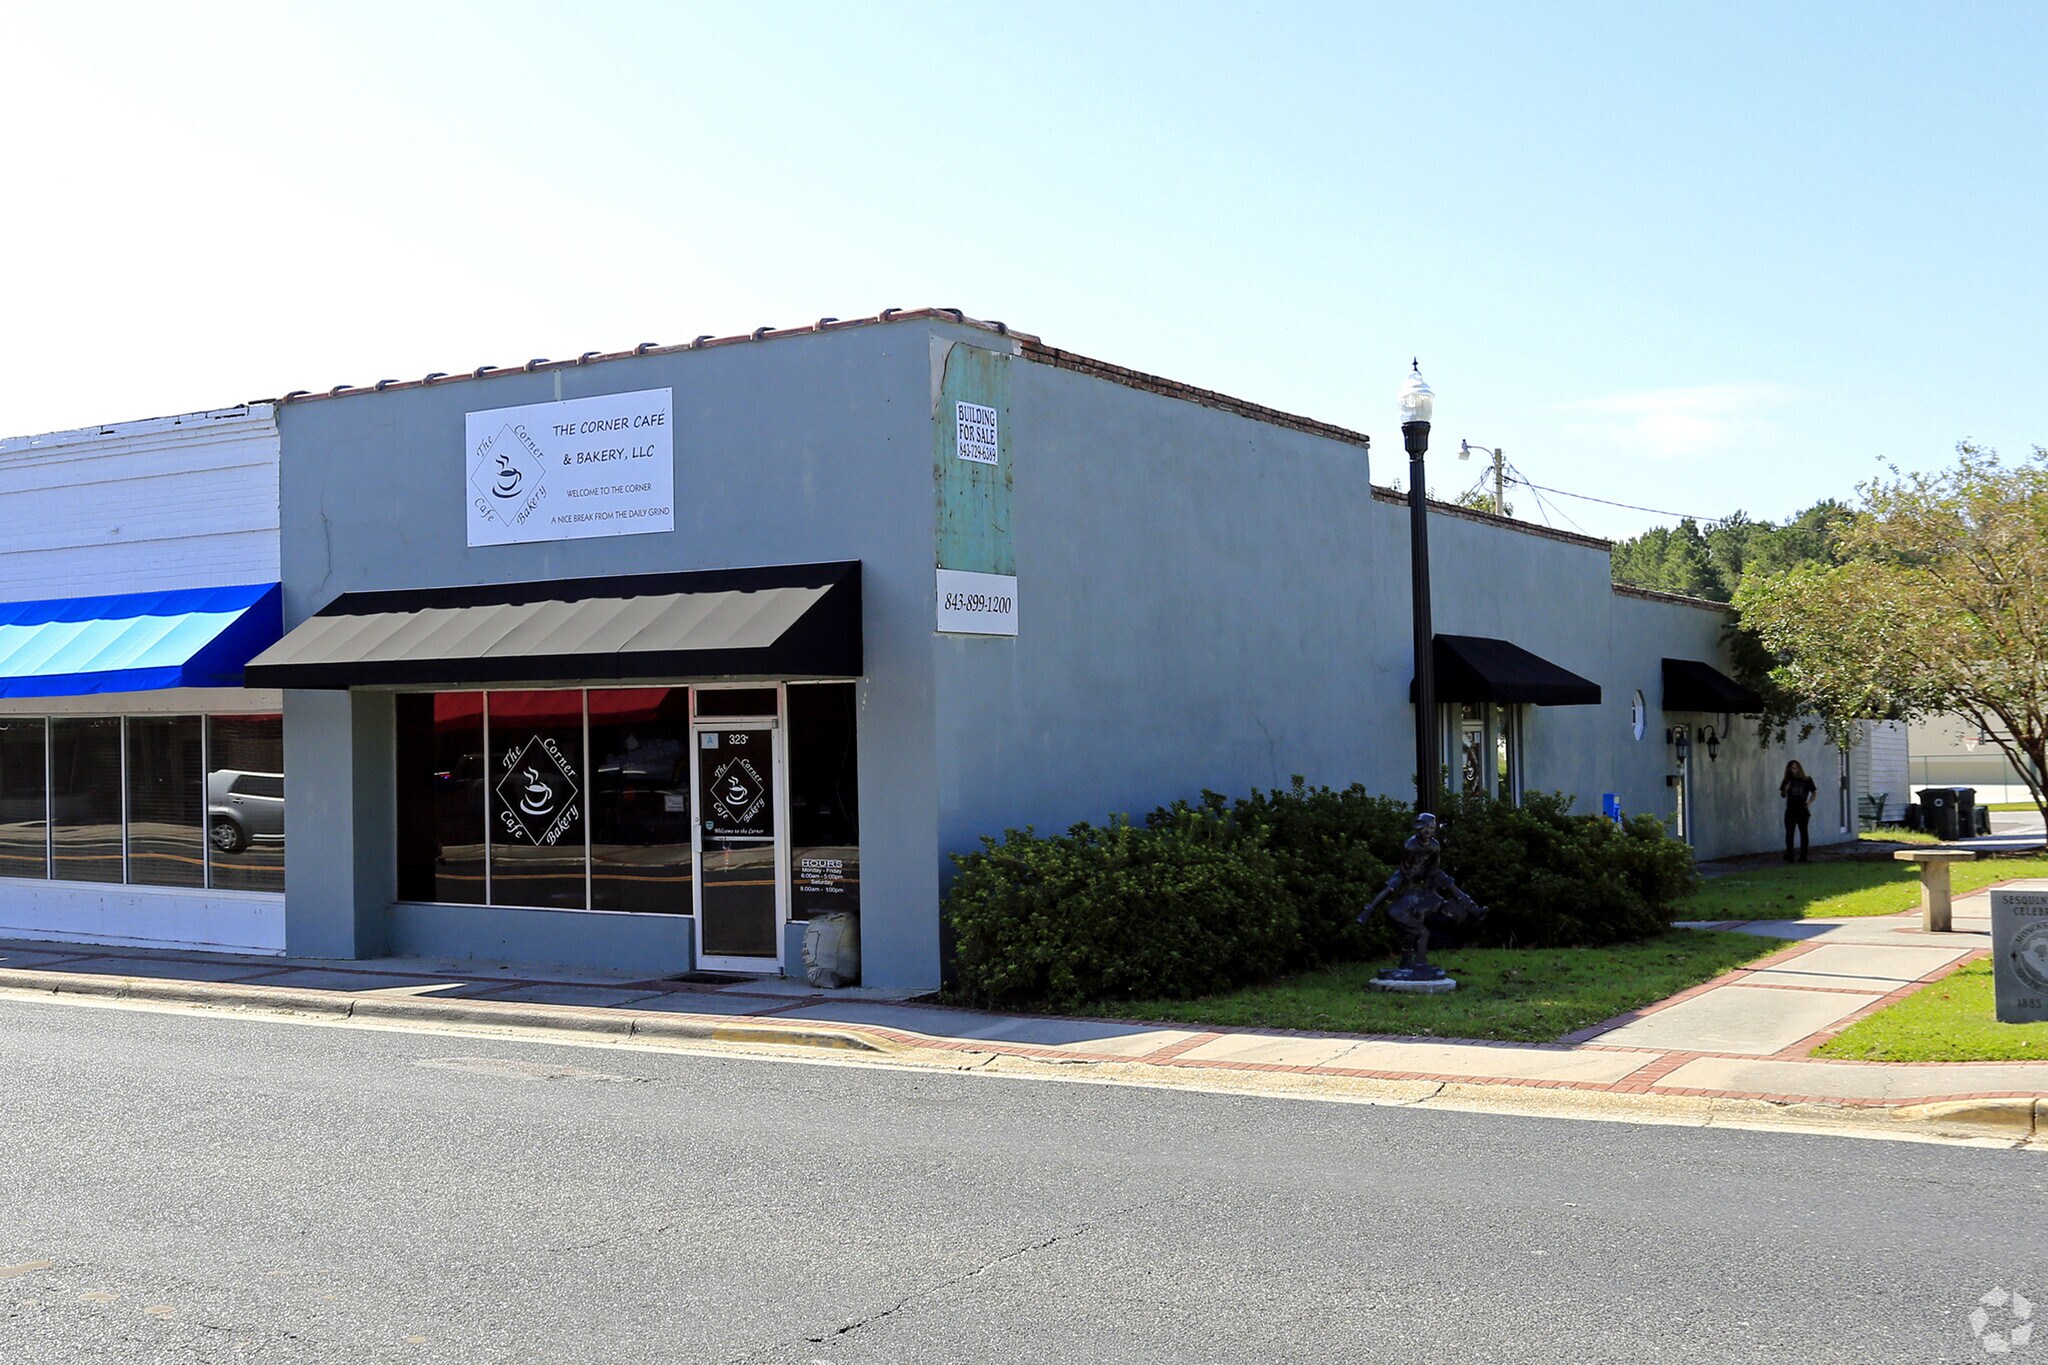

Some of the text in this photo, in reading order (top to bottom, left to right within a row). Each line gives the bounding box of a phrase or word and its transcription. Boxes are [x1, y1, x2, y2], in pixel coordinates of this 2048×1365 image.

[553, 408, 666, 437] THE CORNER CAFÉ
[958, 405, 996, 427] BUILDING
[476, 424, 545, 459] The Corner
[959, 423, 996, 446] FOR SALE
[563, 444, 655, 466] & BAKERY, LLC
[566, 482, 652, 498] WELCOME TO THE CORNER
[474, 485, 548, 526] Cafe Bakery
[551, 506, 670, 525] A NICE BREAK FROM THE DAILY GRIND
[944, 592, 1012, 614] 843-899-1200
[728, 734, 748, 745] 323
[502, 738, 577, 777] The Corner
[714, 758, 763, 782] The Corner
[713, 798, 765, 823] Cafe Bakery
[500, 805, 579, 846] Cafe Bakery
[802, 859, 842, 867] HOURS
[2017, 998, 2042, 1009] 1885
